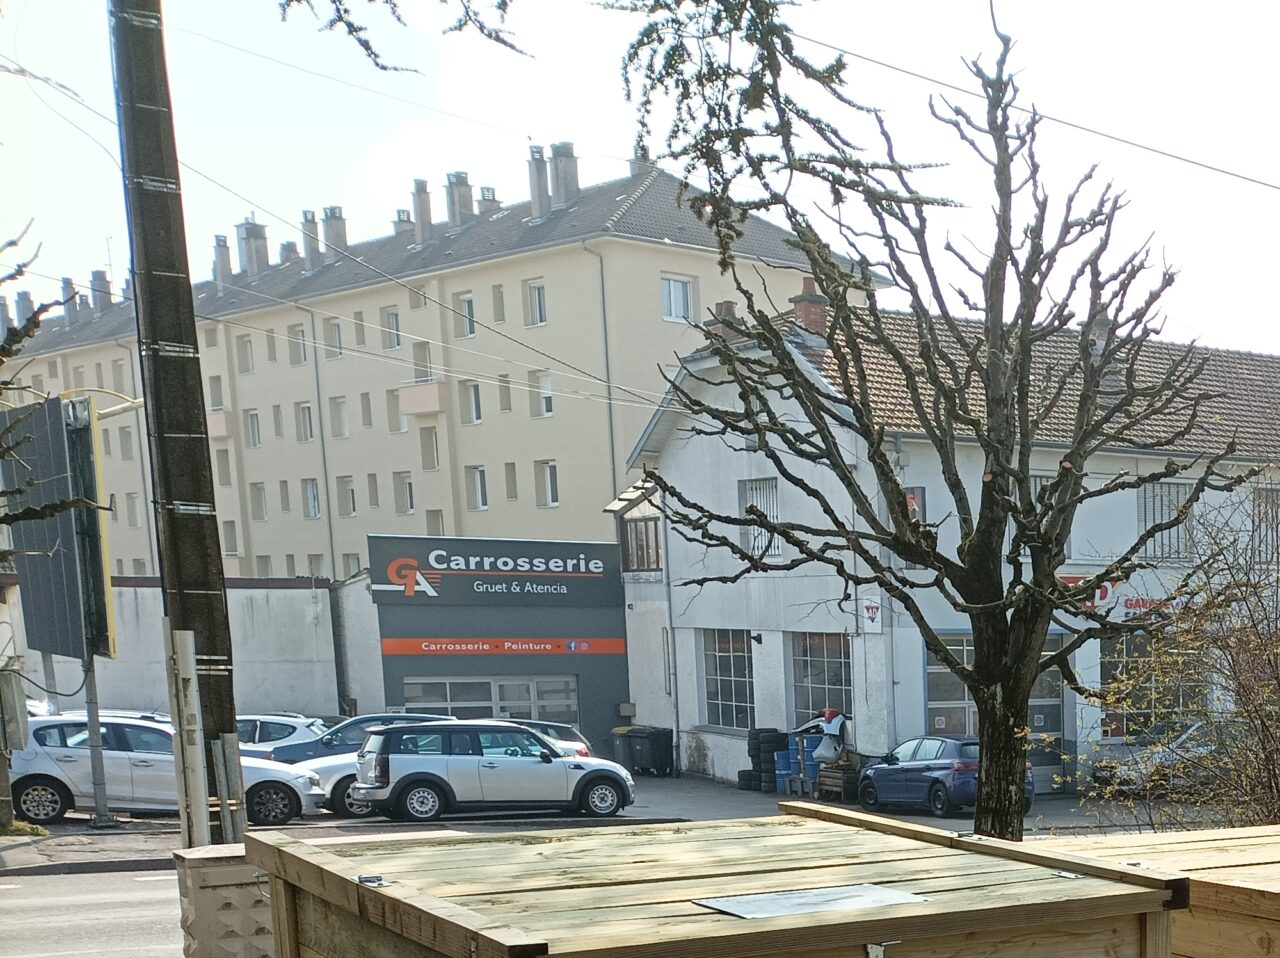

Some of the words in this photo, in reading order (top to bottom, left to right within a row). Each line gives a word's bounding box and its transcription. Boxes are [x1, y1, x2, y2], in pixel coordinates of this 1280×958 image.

[428, 549, 604, 573] Carrosserie
[473, 581, 507, 593] Gruet
[511, 582, 521, 593] &
[524, 583, 568, 594] Atencia
[421, 642, 490, 650] Carrosserie
[504, 642, 552, 650] Peinture
